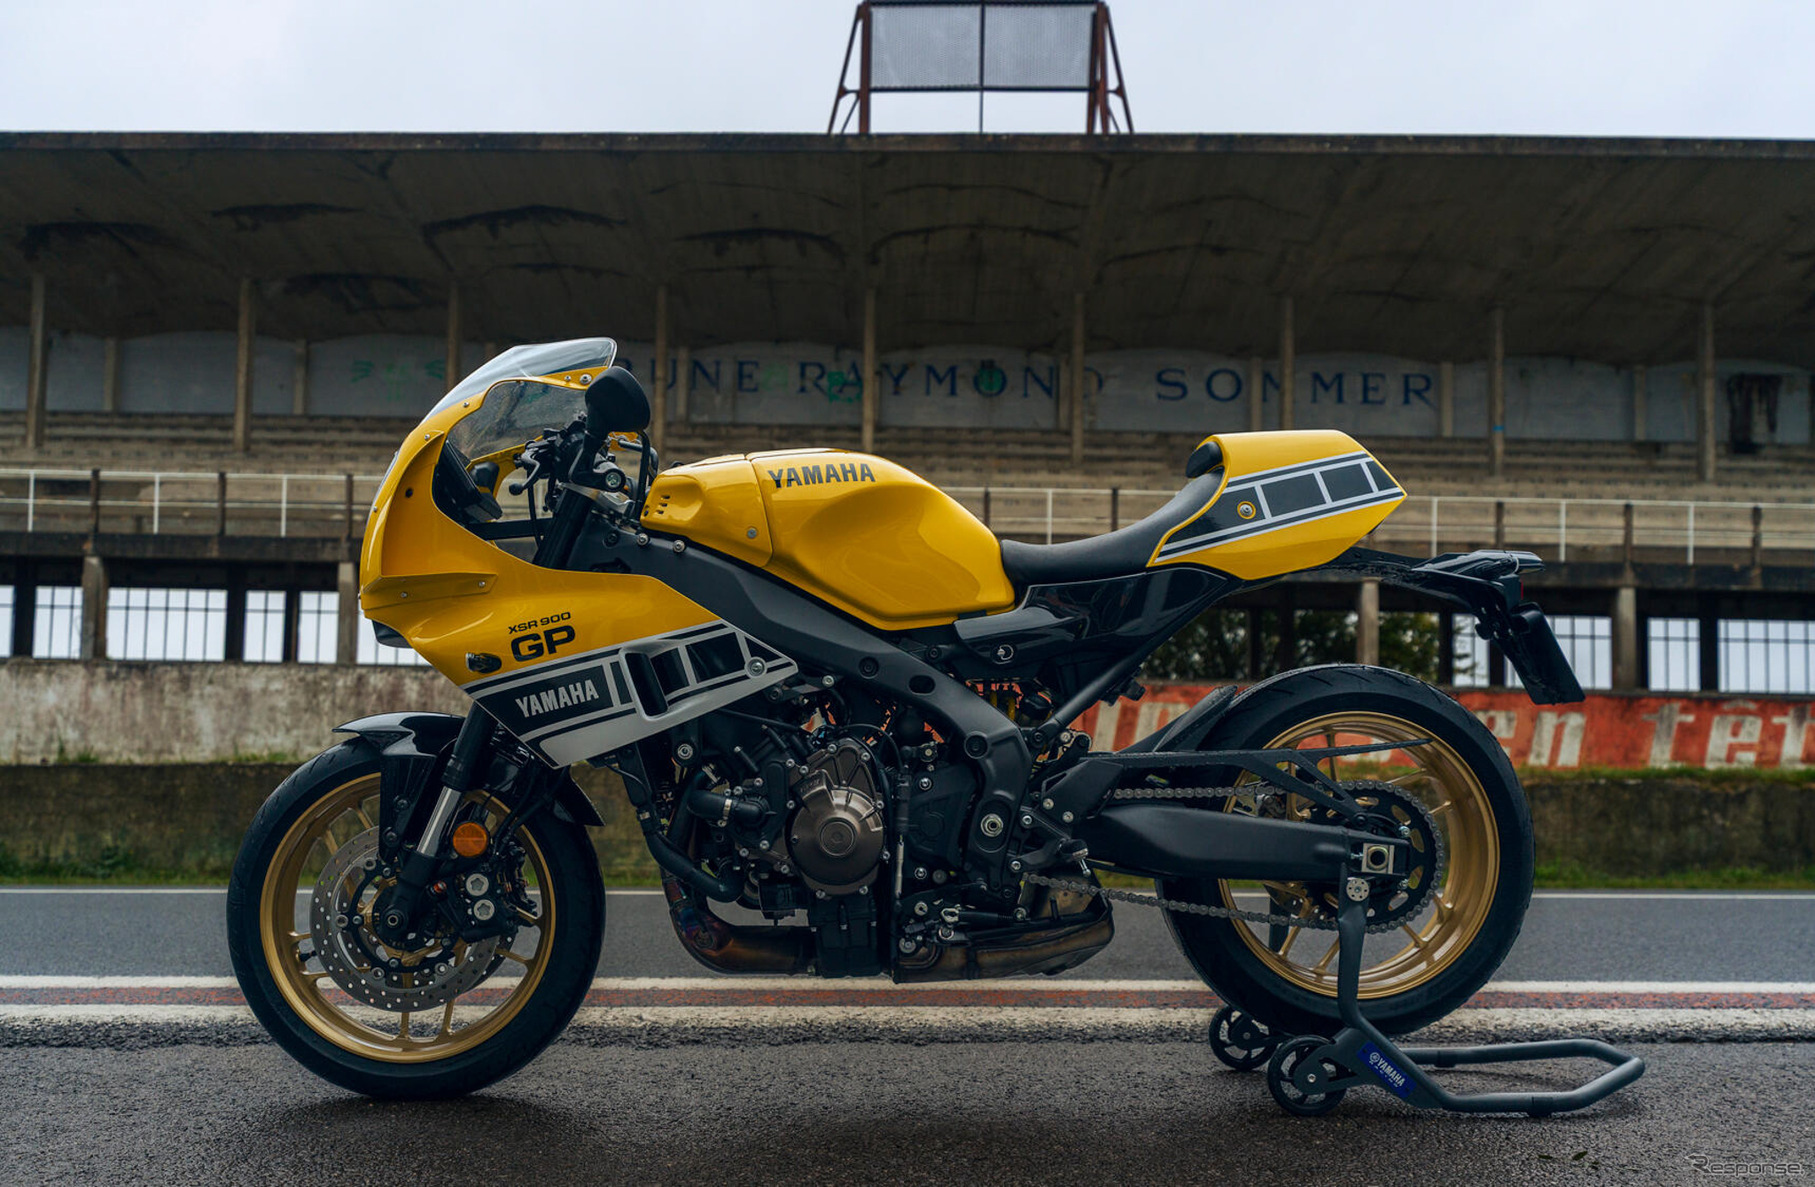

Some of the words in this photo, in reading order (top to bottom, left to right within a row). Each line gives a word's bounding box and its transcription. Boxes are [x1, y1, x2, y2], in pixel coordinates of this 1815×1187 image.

[614, 358, 759, 394] UNE
[767, 463, 876, 489] YAMAHA
[508, 619, 538, 635] XSR
[540, 611, 572, 627] 900
[510, 625, 576, 662] GP
[515, 679, 599, 719] YAMAHA
[1377, 1057, 1406, 1087] YAMAHA
